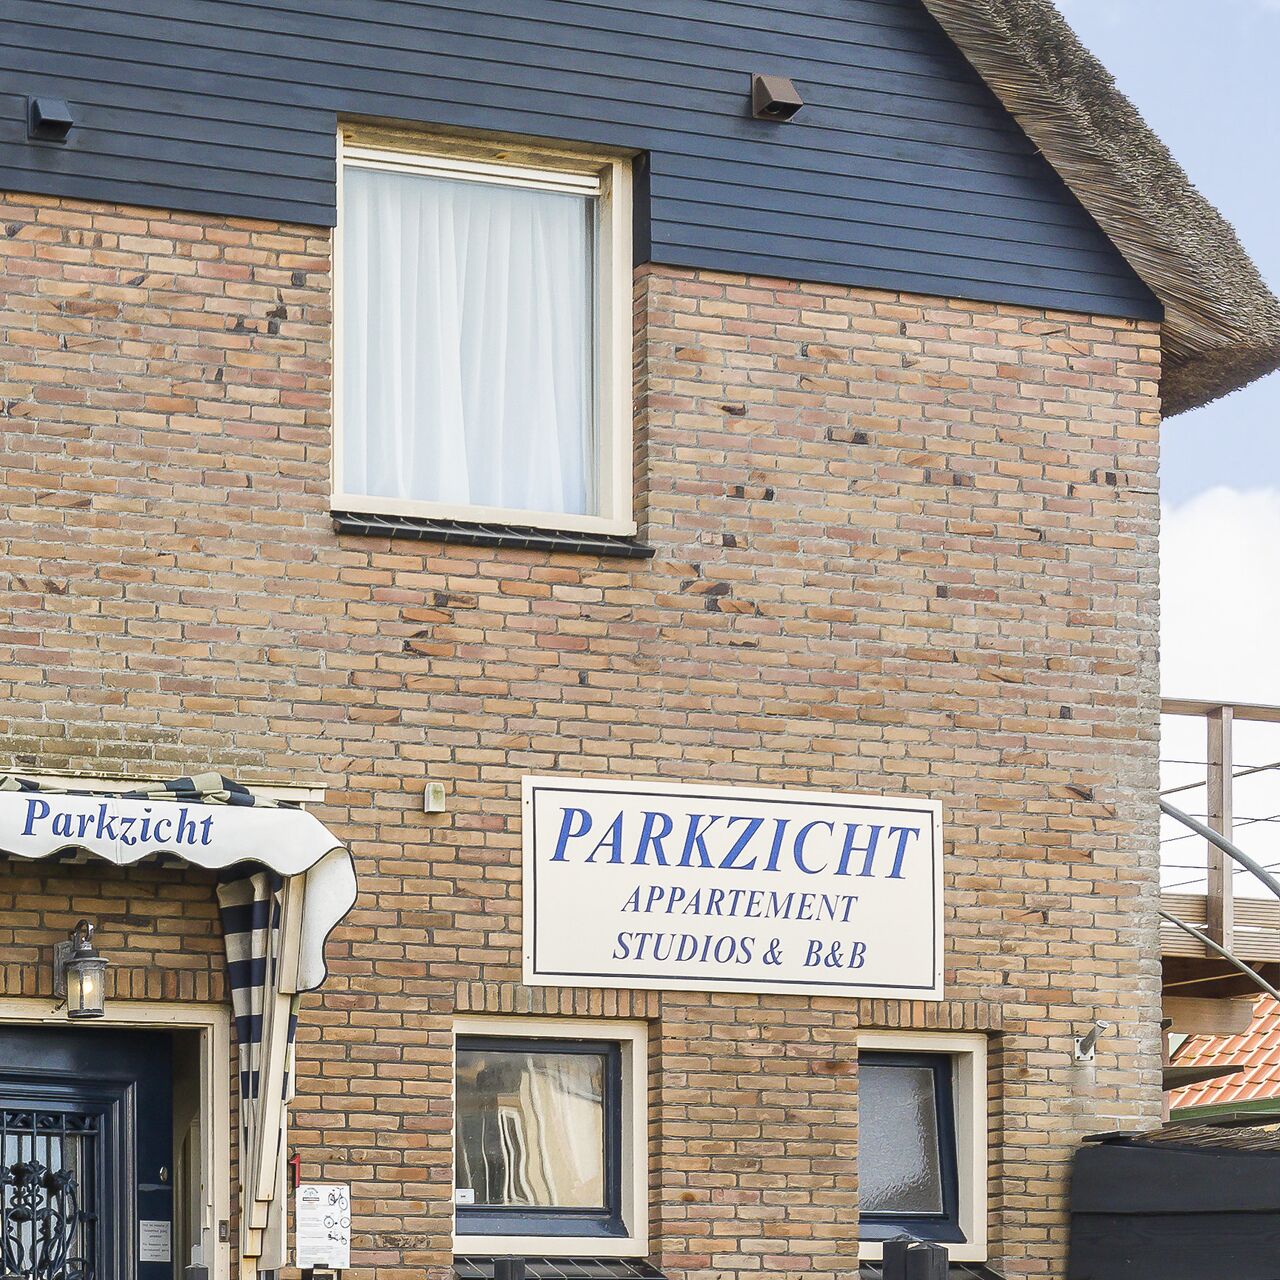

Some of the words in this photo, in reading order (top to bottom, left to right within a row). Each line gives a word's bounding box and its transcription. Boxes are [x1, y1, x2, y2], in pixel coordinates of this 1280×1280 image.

[20, 798, 215, 846] Parkzicht
[549, 807, 921, 879] PARKZICHT
[620, 885, 858, 923] APPARTEMENT
[612, 931, 755, 965] STUDIOS
[762, 940, 784, 967] &
[803, 940, 868, 970] B&B
